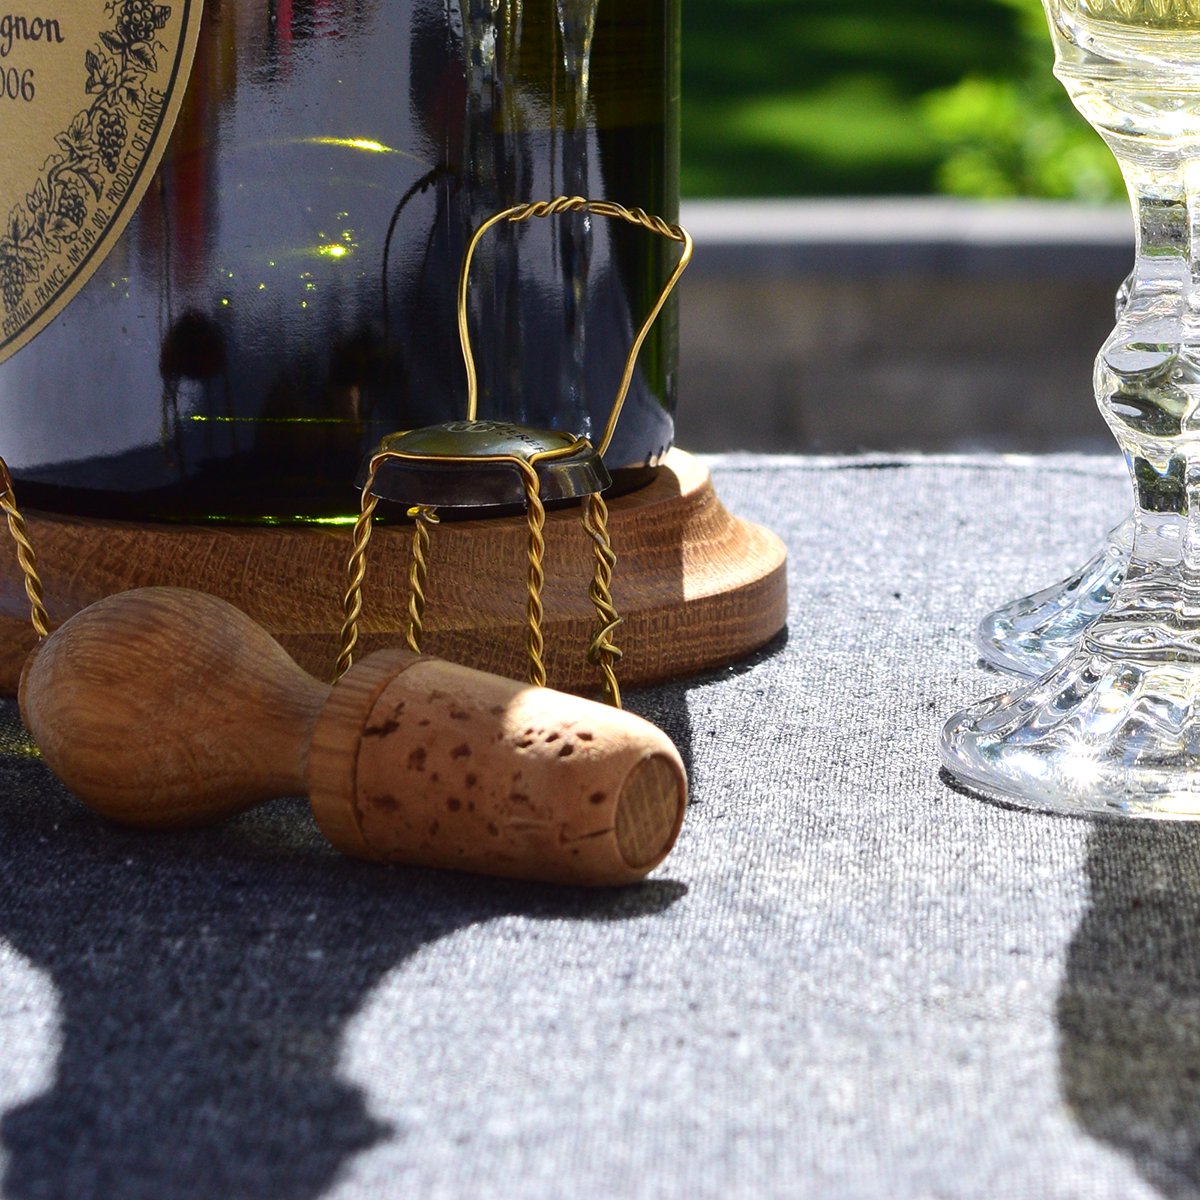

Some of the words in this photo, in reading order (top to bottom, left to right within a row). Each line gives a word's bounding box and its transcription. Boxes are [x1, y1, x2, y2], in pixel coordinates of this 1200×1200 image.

[0, 14, 65, 57] gnon
[138, 87, 166, 135] FRANCE
[131, 133, 149, 152] OF
[106, 151, 141, 205] PRODUCT
[35, 263, 68, 306] FRANCE
